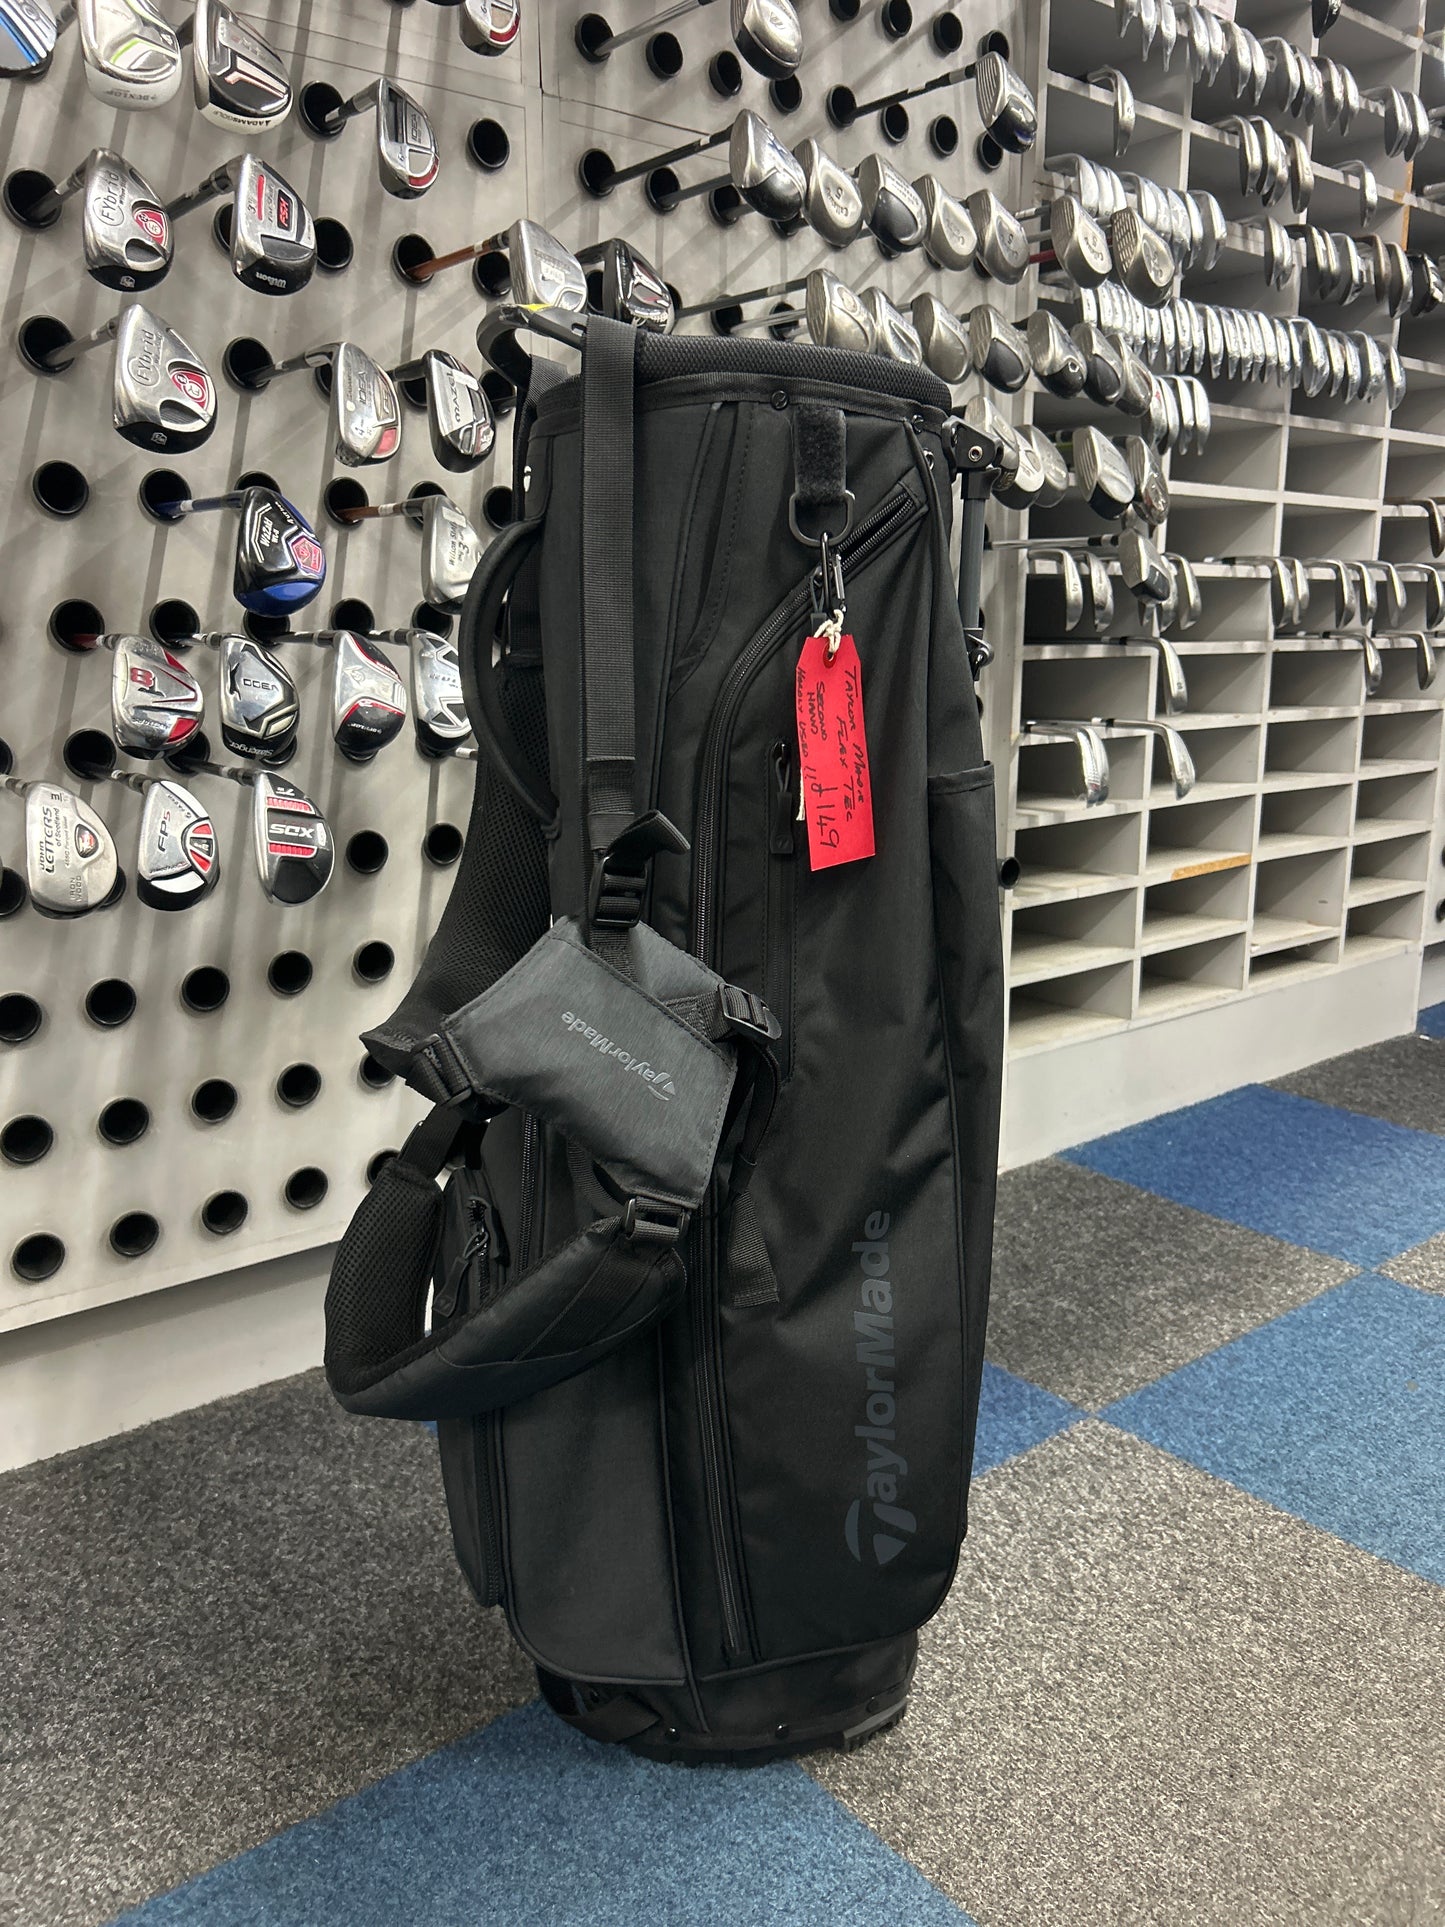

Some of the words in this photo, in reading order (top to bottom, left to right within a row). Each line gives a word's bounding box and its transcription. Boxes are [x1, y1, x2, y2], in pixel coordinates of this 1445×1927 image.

[101, 172, 119, 221] FYbrid
[256, 271, 287, 289] Wilson
[137, 329, 156, 381] FYbrid
[358, 370, 367, 405] IDEA
[807, 691, 819, 735] HAND
[816, 681, 828, 741] SECOND
[844, 775, 856, 822] TEC
[43, 806, 55, 874] LETTERS
[158, 810, 171, 852] FP5
[268, 823, 315, 839] XDS
[561, 1011, 677, 1101] TaylorMade
[844, 1210, 918, 1566] TaylorMade
